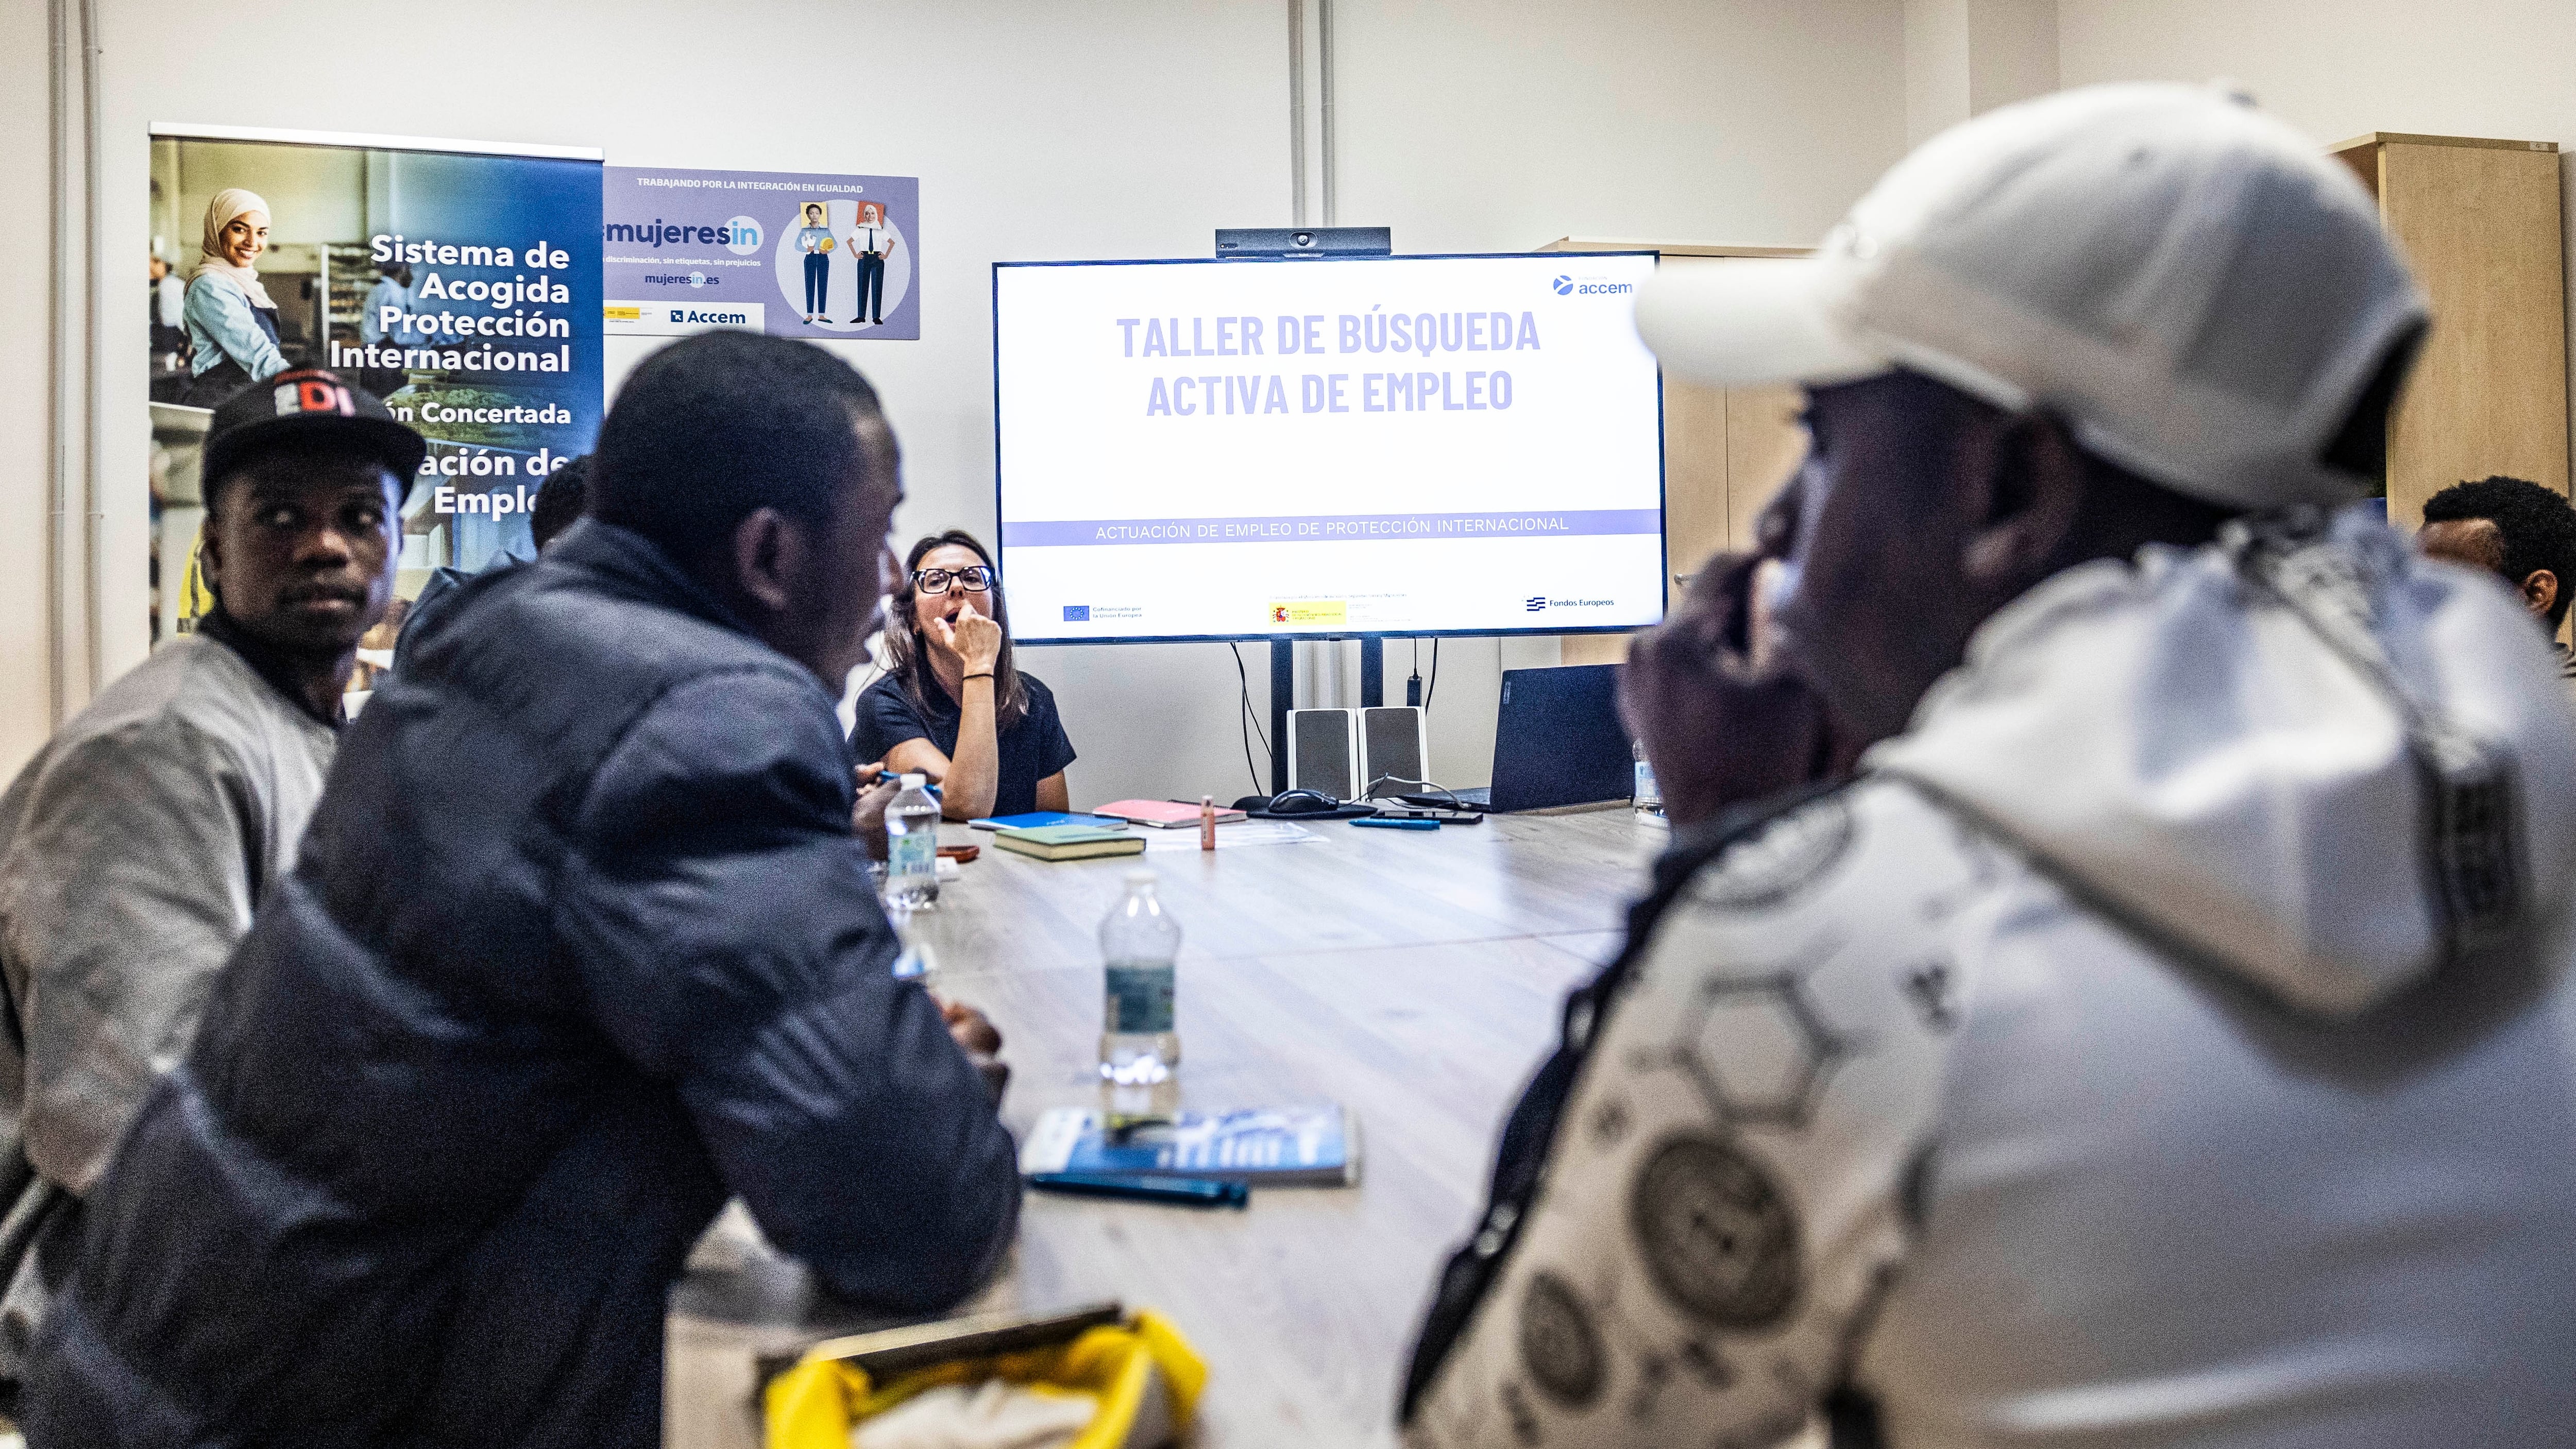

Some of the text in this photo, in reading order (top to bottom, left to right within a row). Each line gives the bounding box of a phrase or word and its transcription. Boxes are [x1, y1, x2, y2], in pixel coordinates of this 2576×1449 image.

[637, 178, 863, 193] TRABAJANDO POR LA INTEGRACIÓN EN IGUALDAD
[602, 218, 758, 248] mujeresin
[371, 235, 570, 269] Sistema de
[606, 256, 662, 264] discriminación,
[675, 257, 712, 266] etiquetas,
[725, 259, 761, 267] prejuicios
[419, 272, 570, 308] Acogida
[645, 274, 720, 286] mujeresin.es
[1579, 283, 1633, 294] accem
[380, 306, 570, 338] Protección
[687, 311, 746, 324] Accem
[1117, 304, 1540, 357] TALLER DE BÚSQUEDA
[331, 340, 570, 372] Internacional
[1146, 370, 1512, 416] ACTIVA DE EMPLEO
[421, 402, 571, 424] Concertada
[418, 448, 515, 475] ación
[1095, 517, 1569, 539] ACTUACIÓN DE EMPLEO DE PROTECCIÓN INTERNACIONAL
